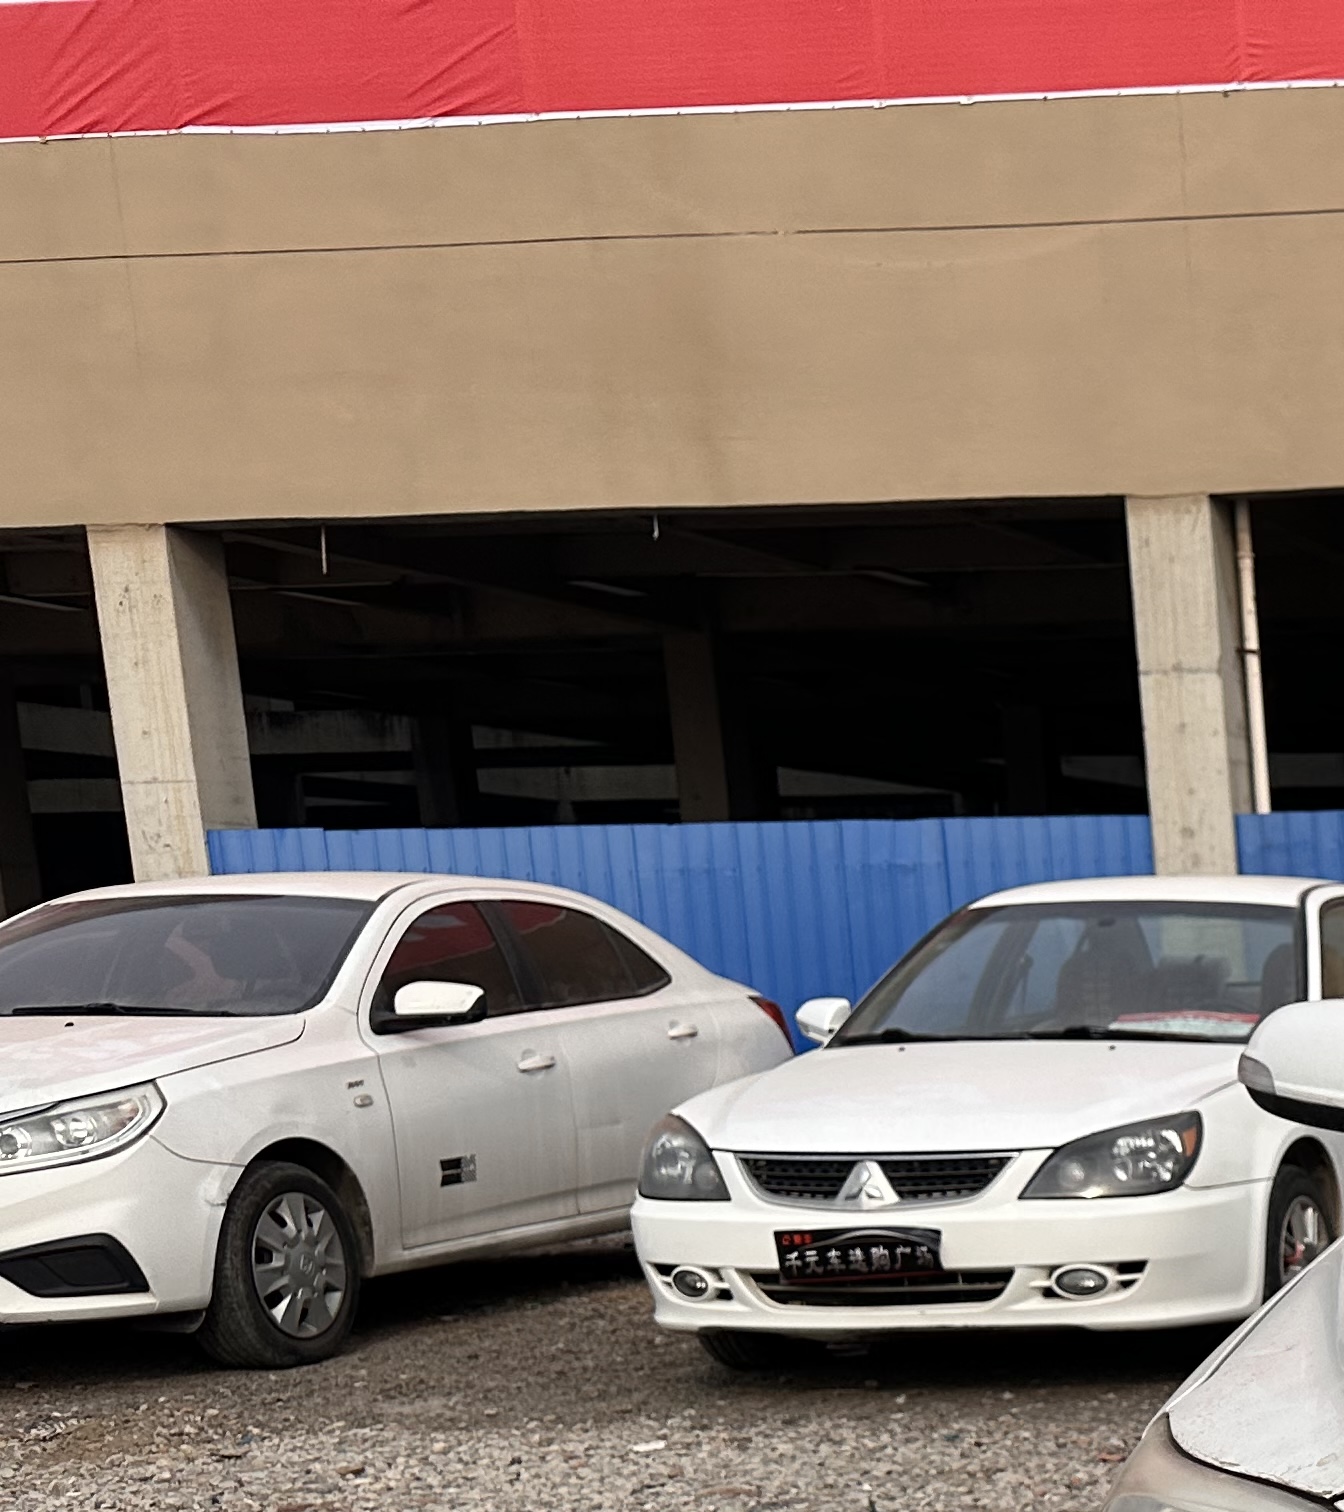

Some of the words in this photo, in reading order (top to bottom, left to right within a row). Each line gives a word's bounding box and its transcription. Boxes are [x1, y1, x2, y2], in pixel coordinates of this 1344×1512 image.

[785, 1245, 934, 1274] 千元车选购广场
